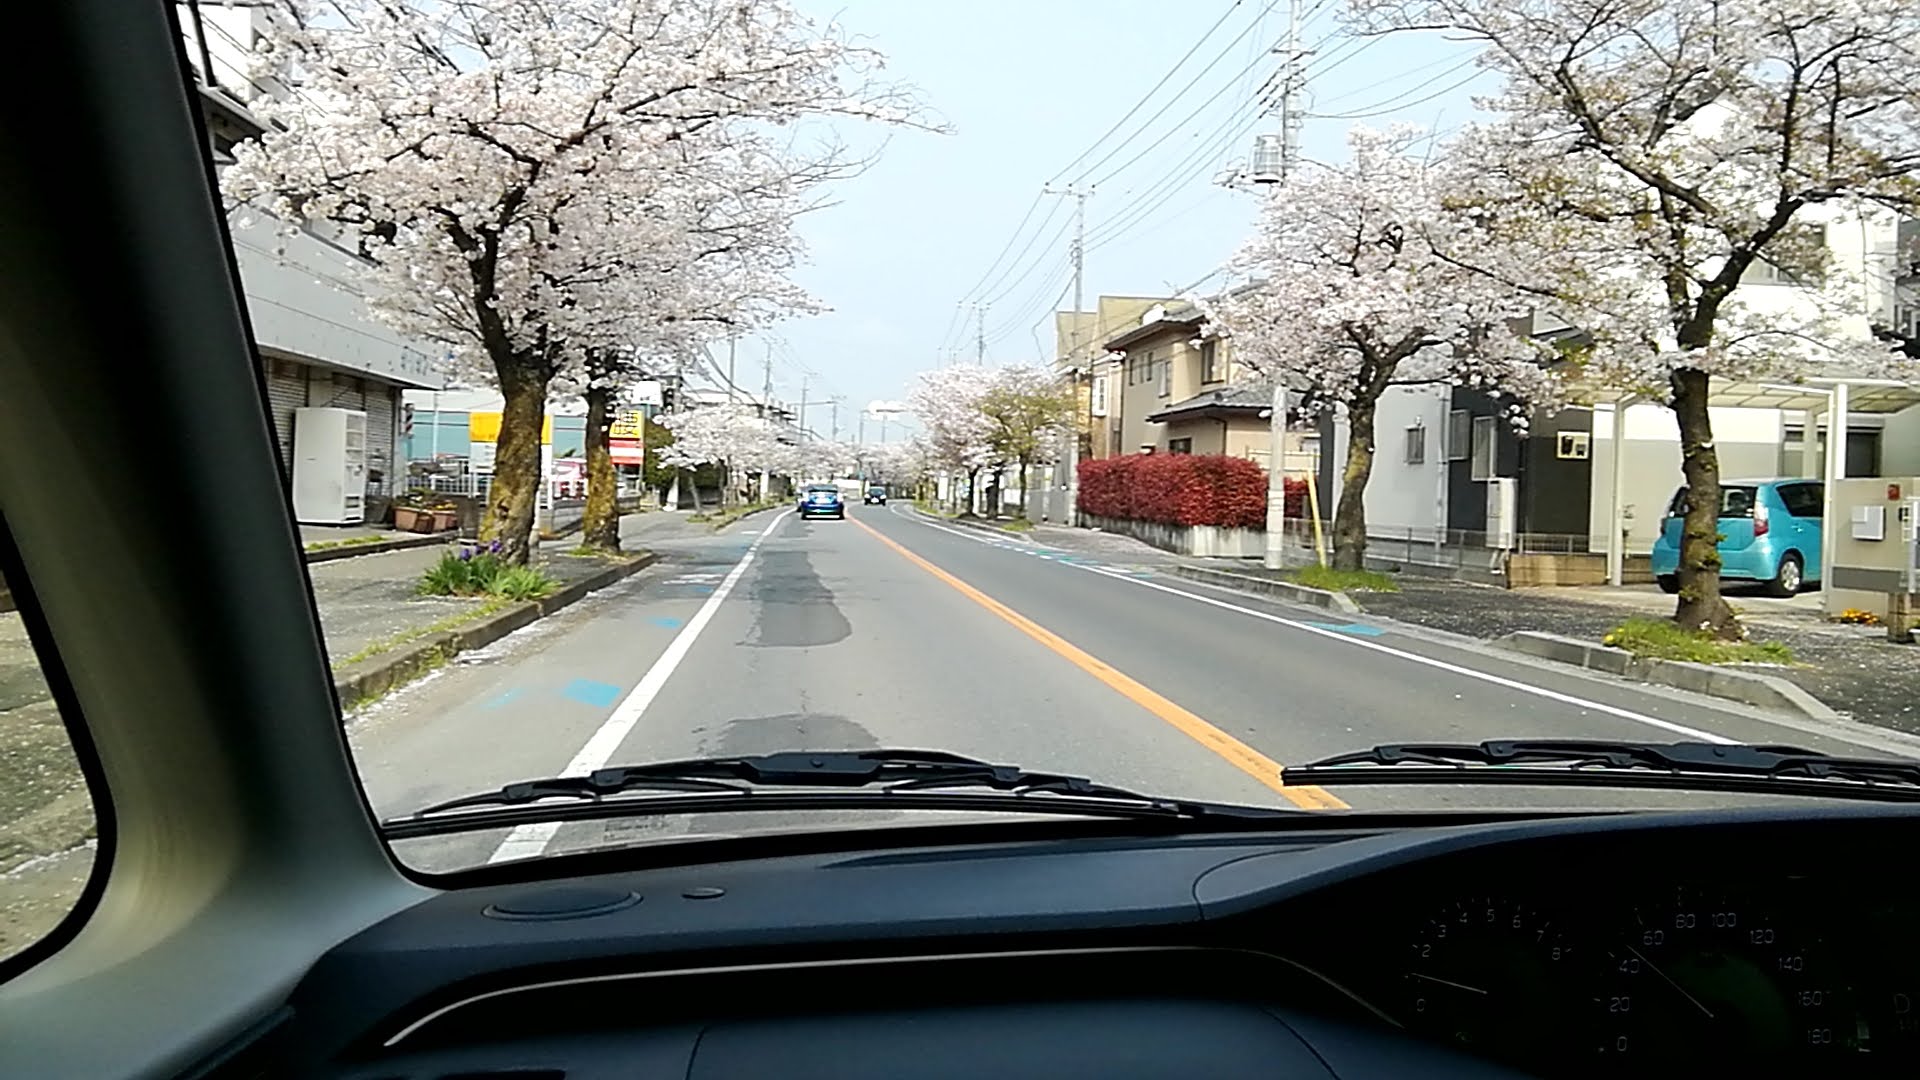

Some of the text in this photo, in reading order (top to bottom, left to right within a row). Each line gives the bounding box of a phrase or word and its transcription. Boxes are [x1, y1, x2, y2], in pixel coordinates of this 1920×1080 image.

[1487, 909, 1495, 922] 5
[1675, 913, 1696, 928] 80
[1438, 924, 1447, 938] 3
[1536, 929, 1545, 944] 7
[1643, 930, 1665, 946] 60
[1750, 929, 1775, 945] 120
[1422, 944, 1432, 958] 2
[1618, 959, 1641, 974] 40
[1778, 956, 1804, 972] 140
[1609, 996, 1631, 1012] 20
[1616, 1035, 1628, 1052] 0
